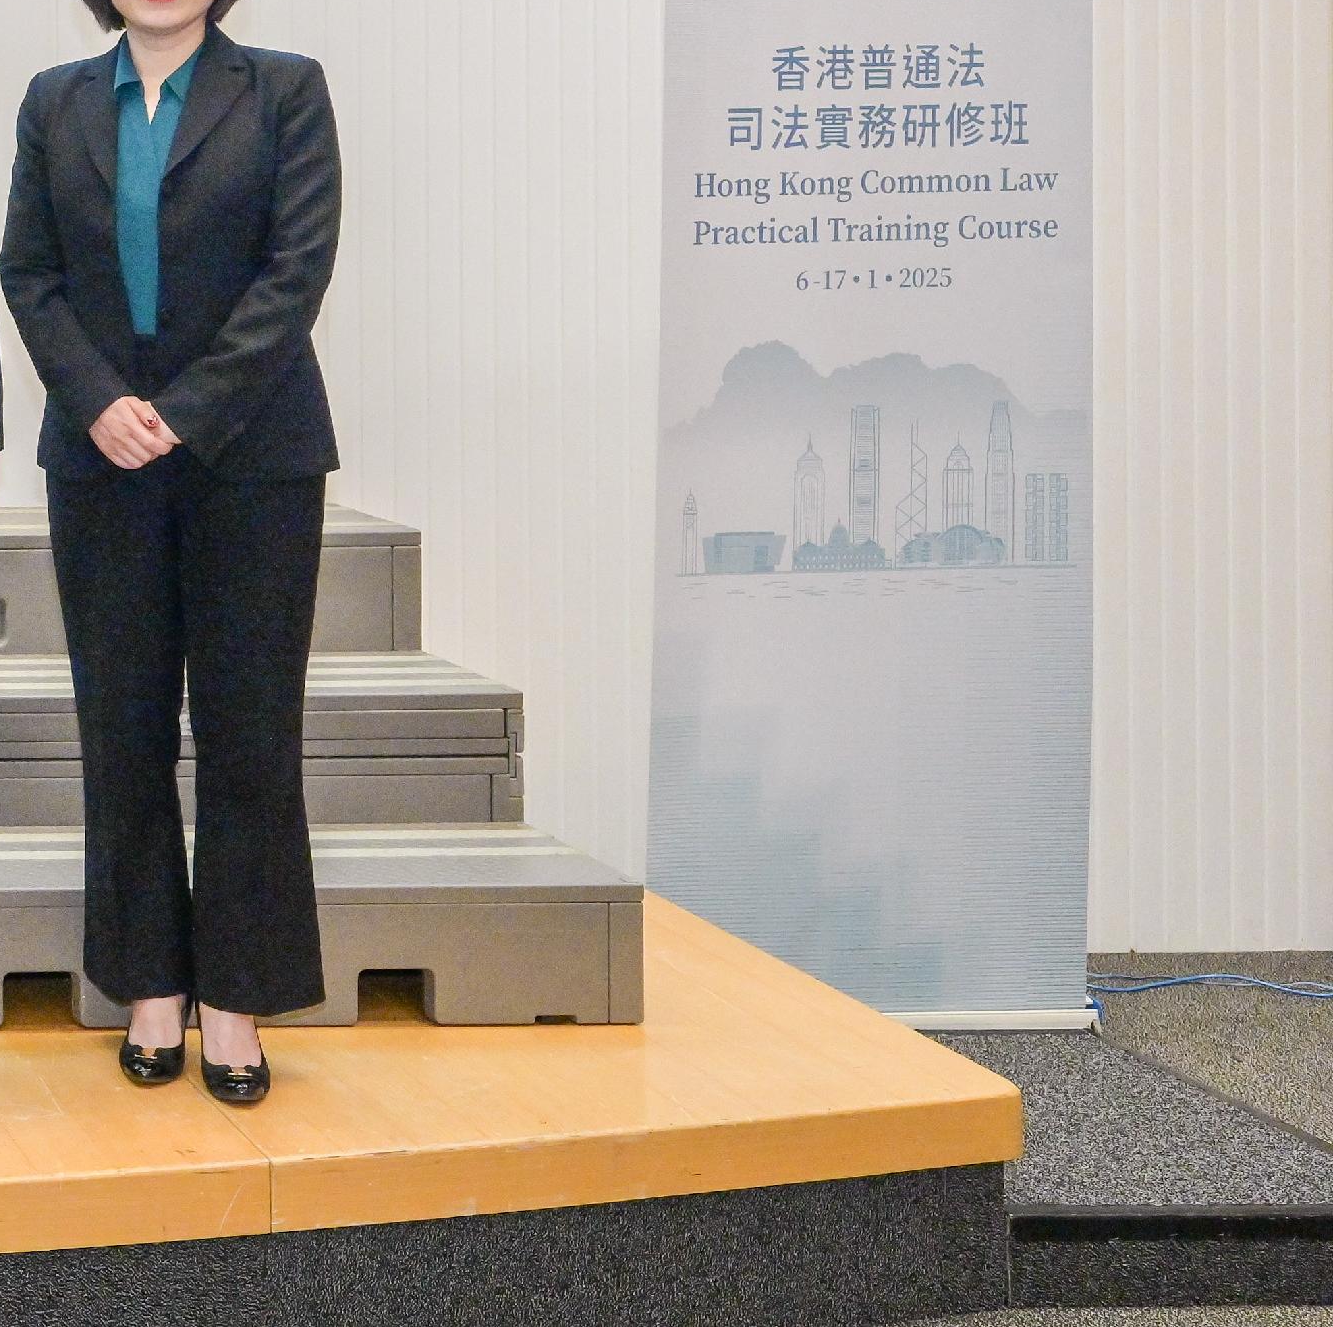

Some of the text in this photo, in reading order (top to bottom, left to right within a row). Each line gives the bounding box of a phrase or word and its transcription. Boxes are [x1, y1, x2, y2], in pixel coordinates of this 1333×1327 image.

[772, 43, 984, 91] 香港普通法
[728, 100, 1029, 150] 司法實務研修班
[695, 168, 1058, 204] Hong Kong Common Law
[693, 214, 1058, 247] Practical Training Course
